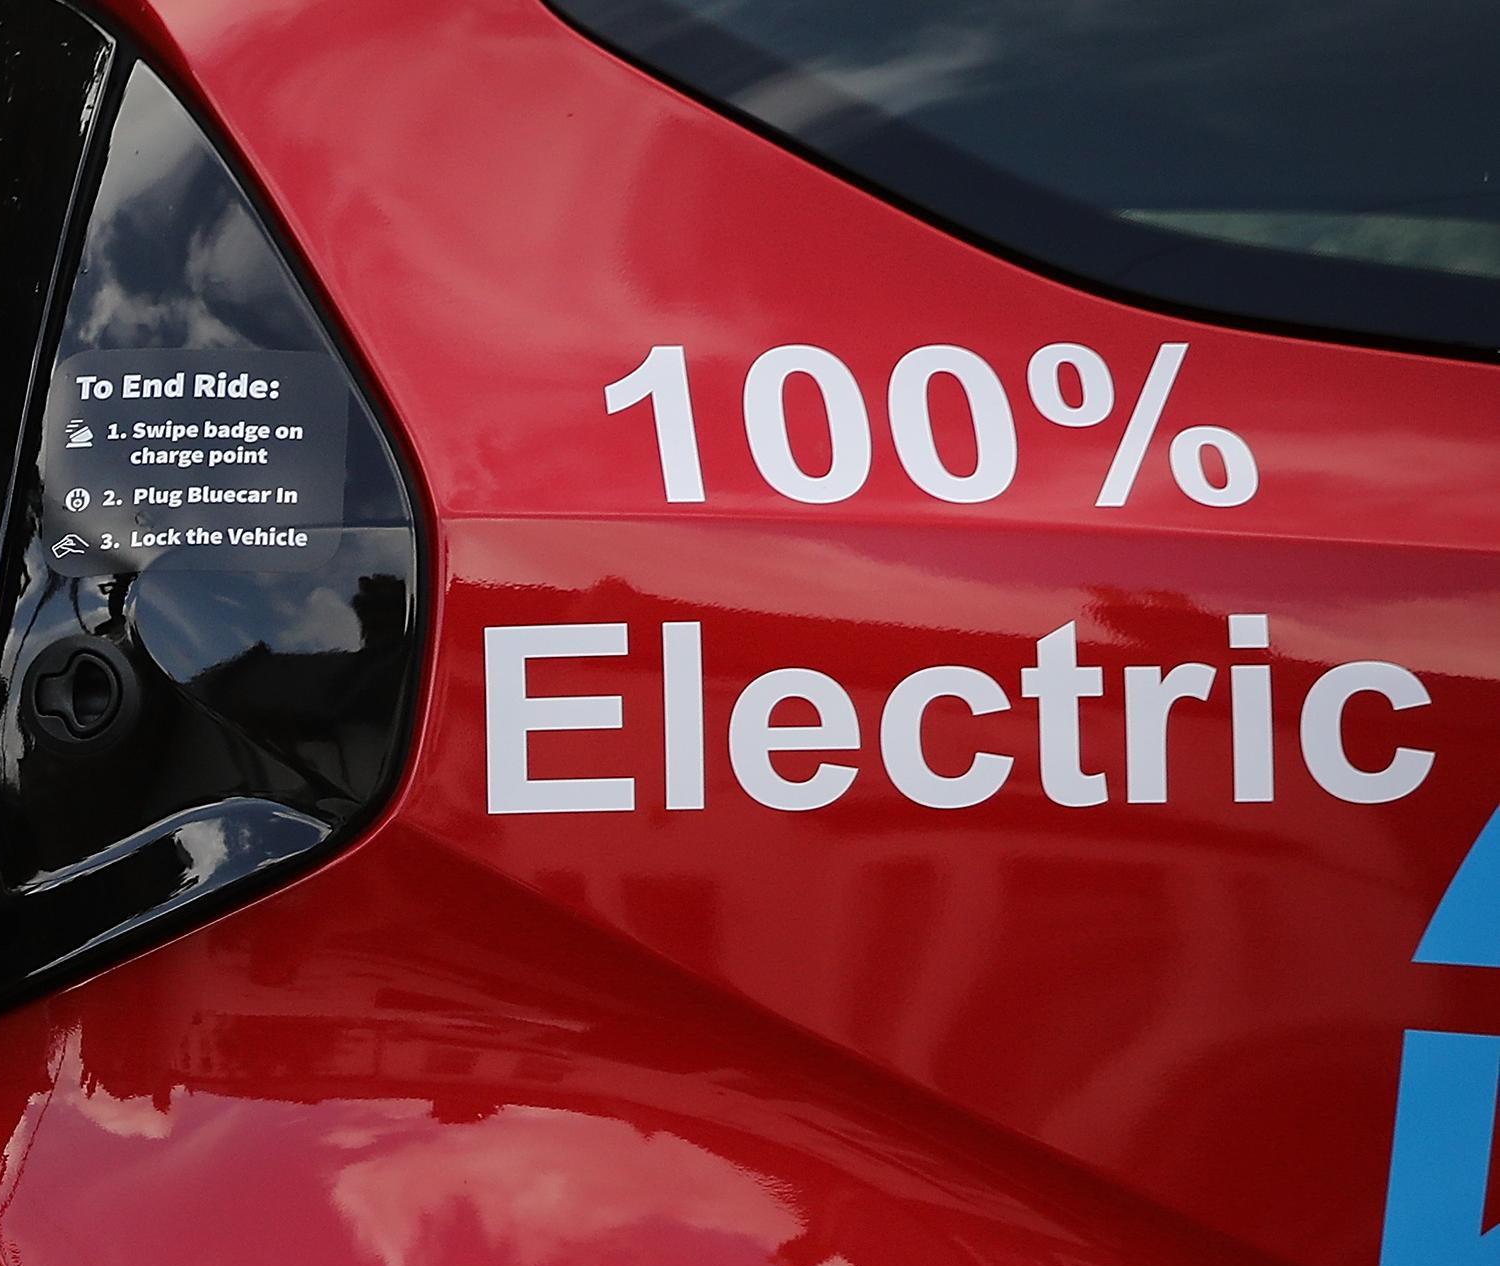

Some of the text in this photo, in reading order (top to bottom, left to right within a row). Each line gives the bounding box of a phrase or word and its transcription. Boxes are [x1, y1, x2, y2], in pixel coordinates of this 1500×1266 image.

[76, 372, 281, 400] To End Ride:
[107, 420, 304, 443] 1. Swipe badge on
[603, 341, 1260, 509] 100%
[130, 446, 269, 468] charge point
[103, 486, 299, 509] 2. Plug Bluecar In
[101, 527, 309, 550] 3. Lock the Vehicle
[483, 613, 1436, 815] Electric
